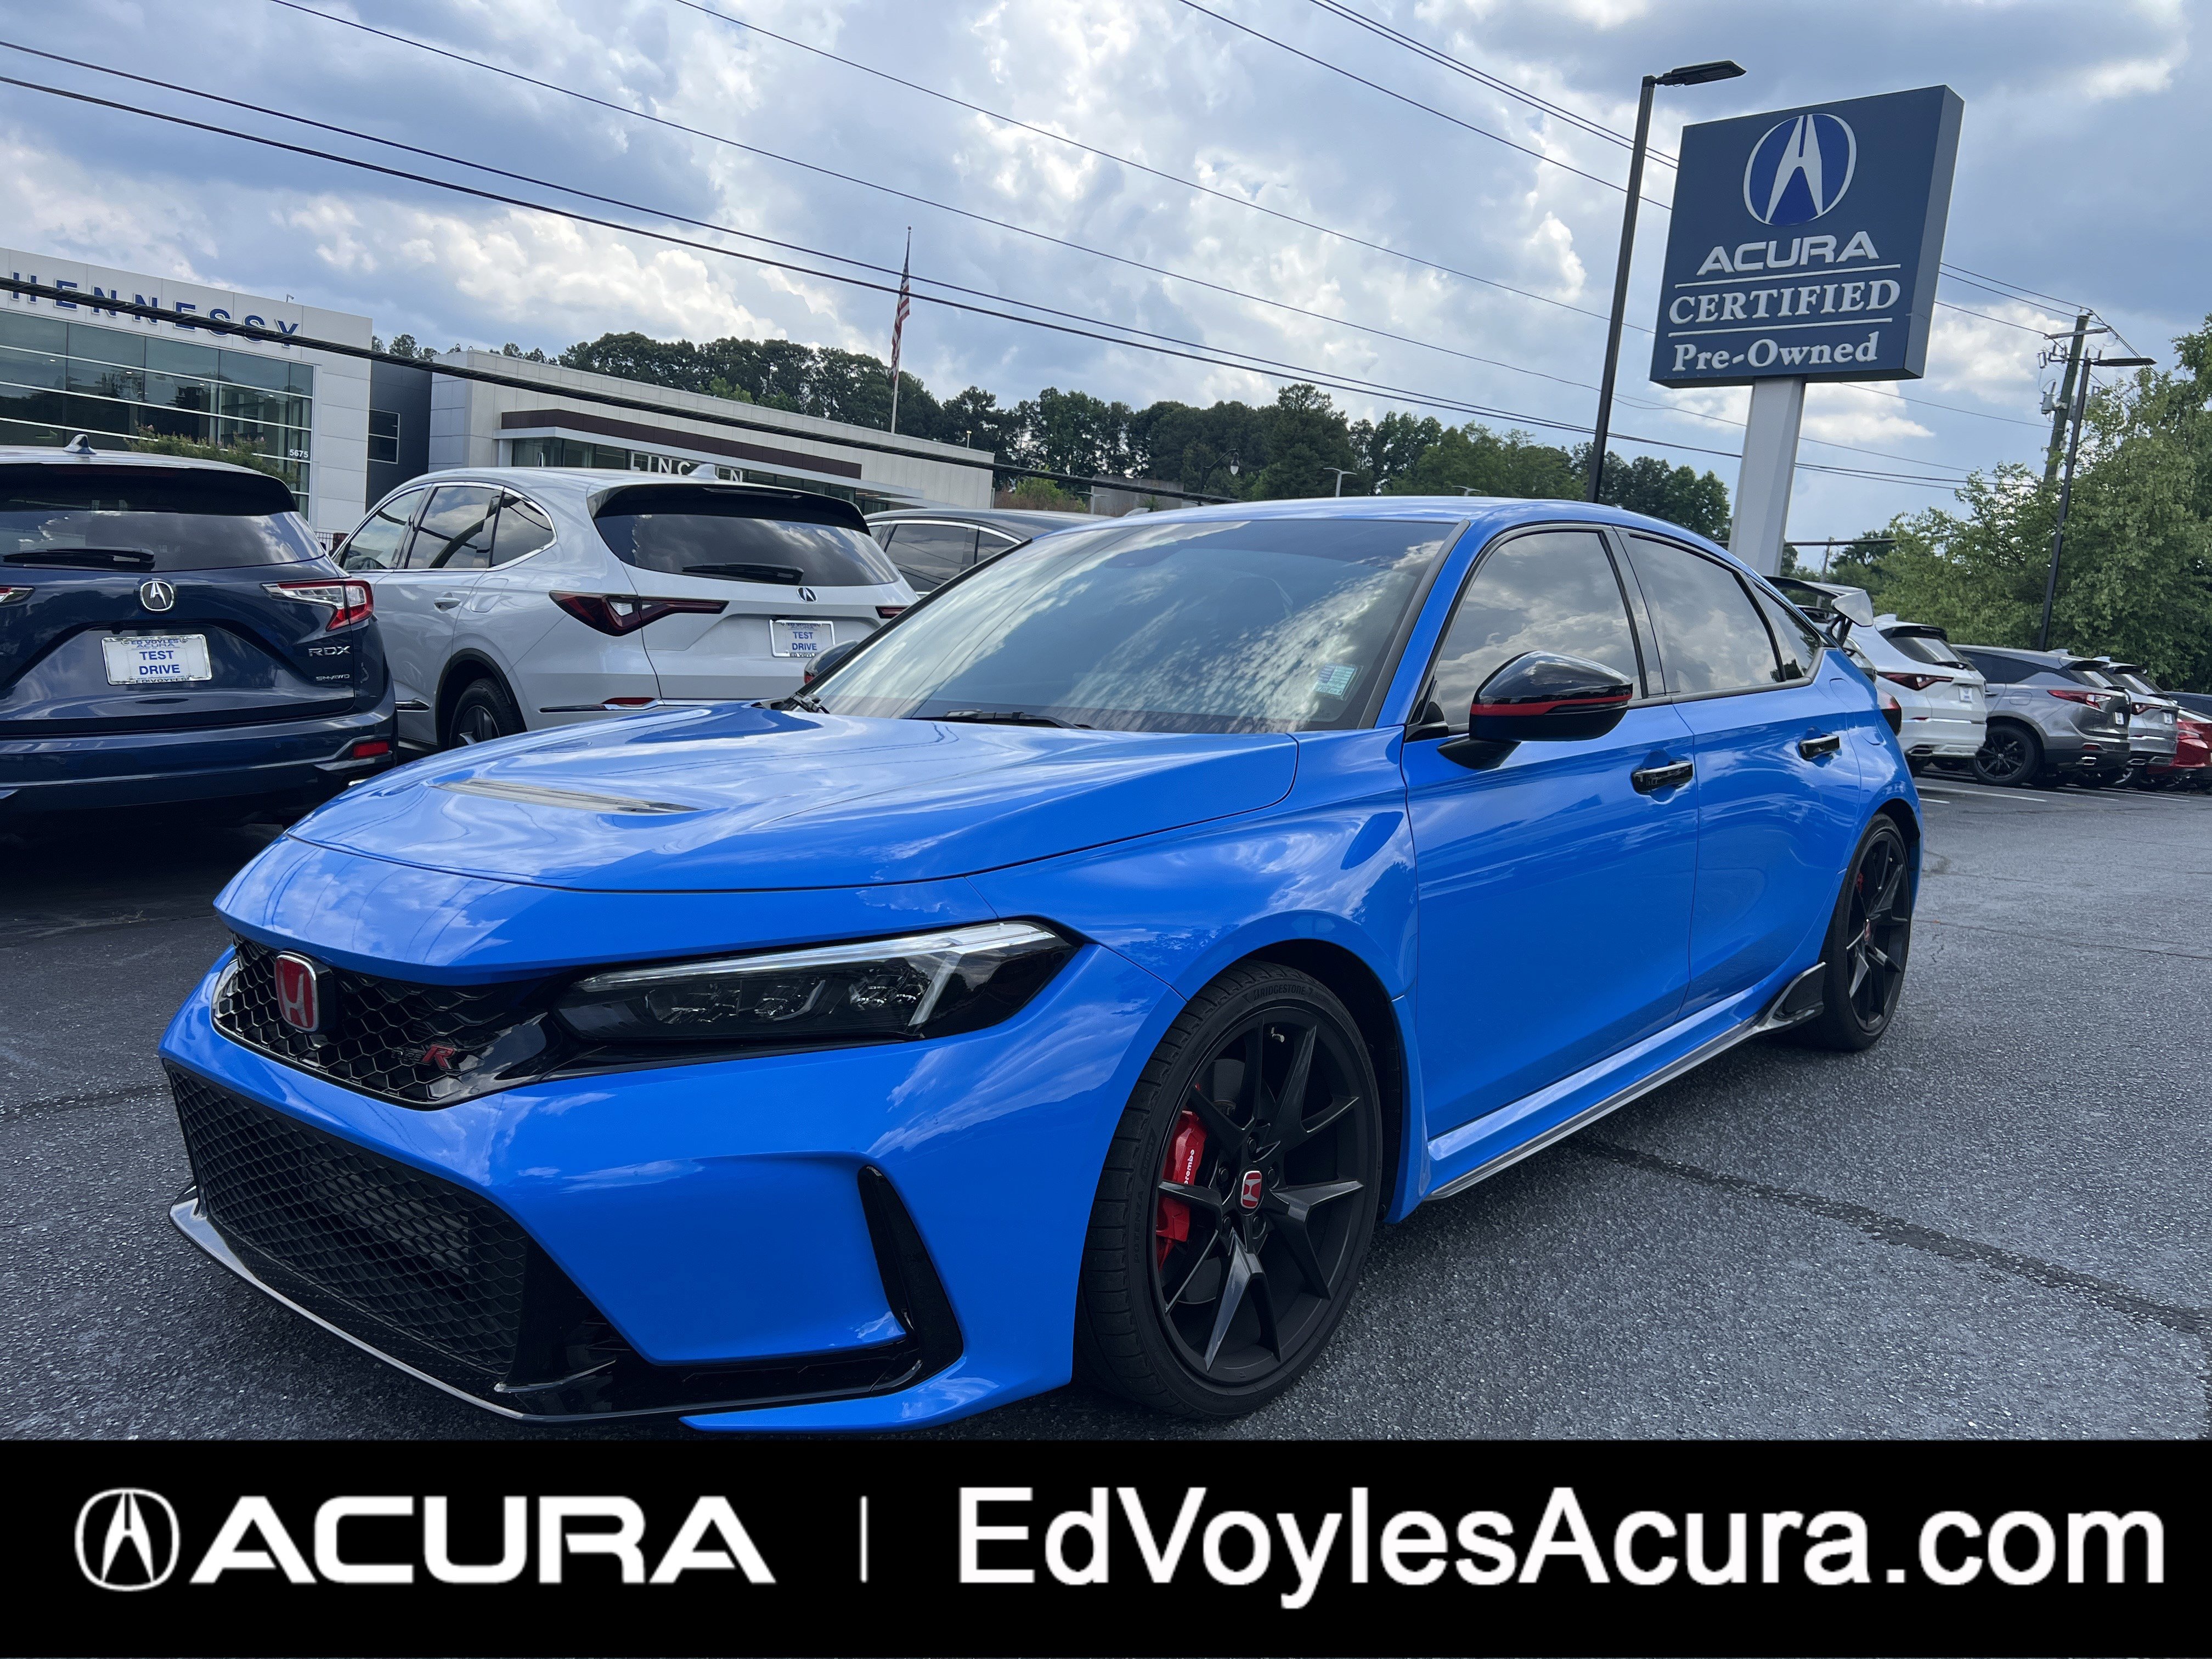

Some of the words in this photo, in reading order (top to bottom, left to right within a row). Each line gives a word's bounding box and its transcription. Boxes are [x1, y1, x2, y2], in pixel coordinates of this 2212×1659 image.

[1696, 230, 1880, 275] ACURA
[11, 271, 300, 349] HENNESSY
[1668, 279, 1901, 325] CERTIFIED
[1672, 330, 1878, 371] Pre-Owned
[289, 449, 309, 458] 5675
[630, 453, 743, 482] LINCN
[792, 631, 813, 640] TEST
[139, 650, 174, 661] TEST
[308, 646, 351, 657] RDX
[139, 664, 180, 675] DRIVE
[1252, 984, 1306, 1001] BRIDGESTONE
[421, 1043, 455, 1071] R
[1133, 1190, 1144, 1264] POTENZA
